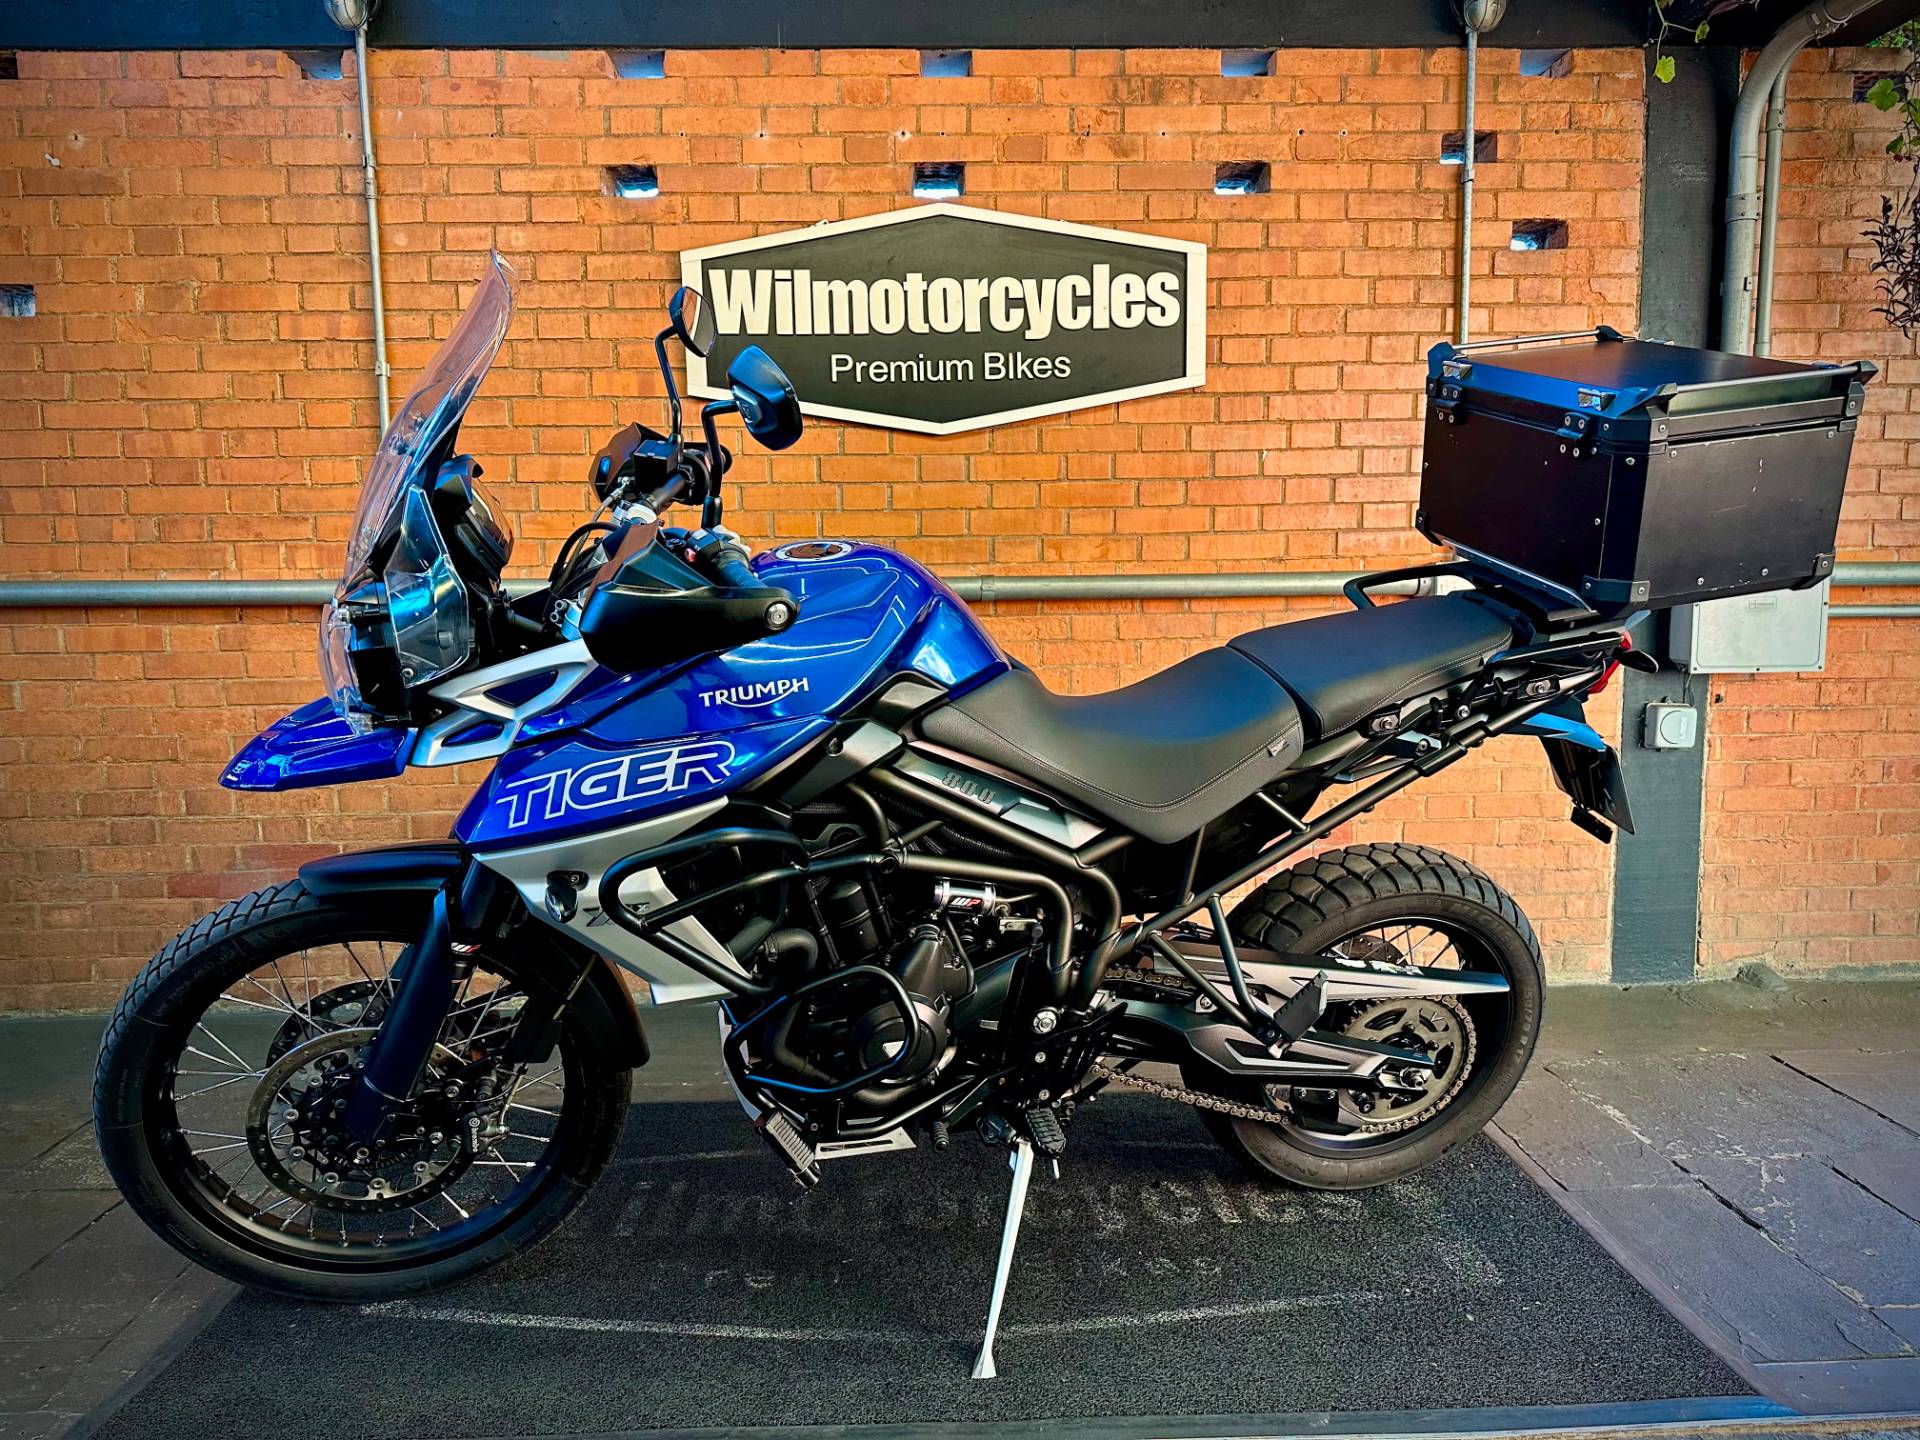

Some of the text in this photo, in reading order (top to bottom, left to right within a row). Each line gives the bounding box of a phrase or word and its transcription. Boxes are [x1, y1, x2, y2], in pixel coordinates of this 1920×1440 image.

[708, 264, 1181, 340] Wilmotorcycles
[830, 353, 975, 383] Premium
[699, 676, 810, 708] TRIUMPH
[496, 741, 736, 829] TIGER
